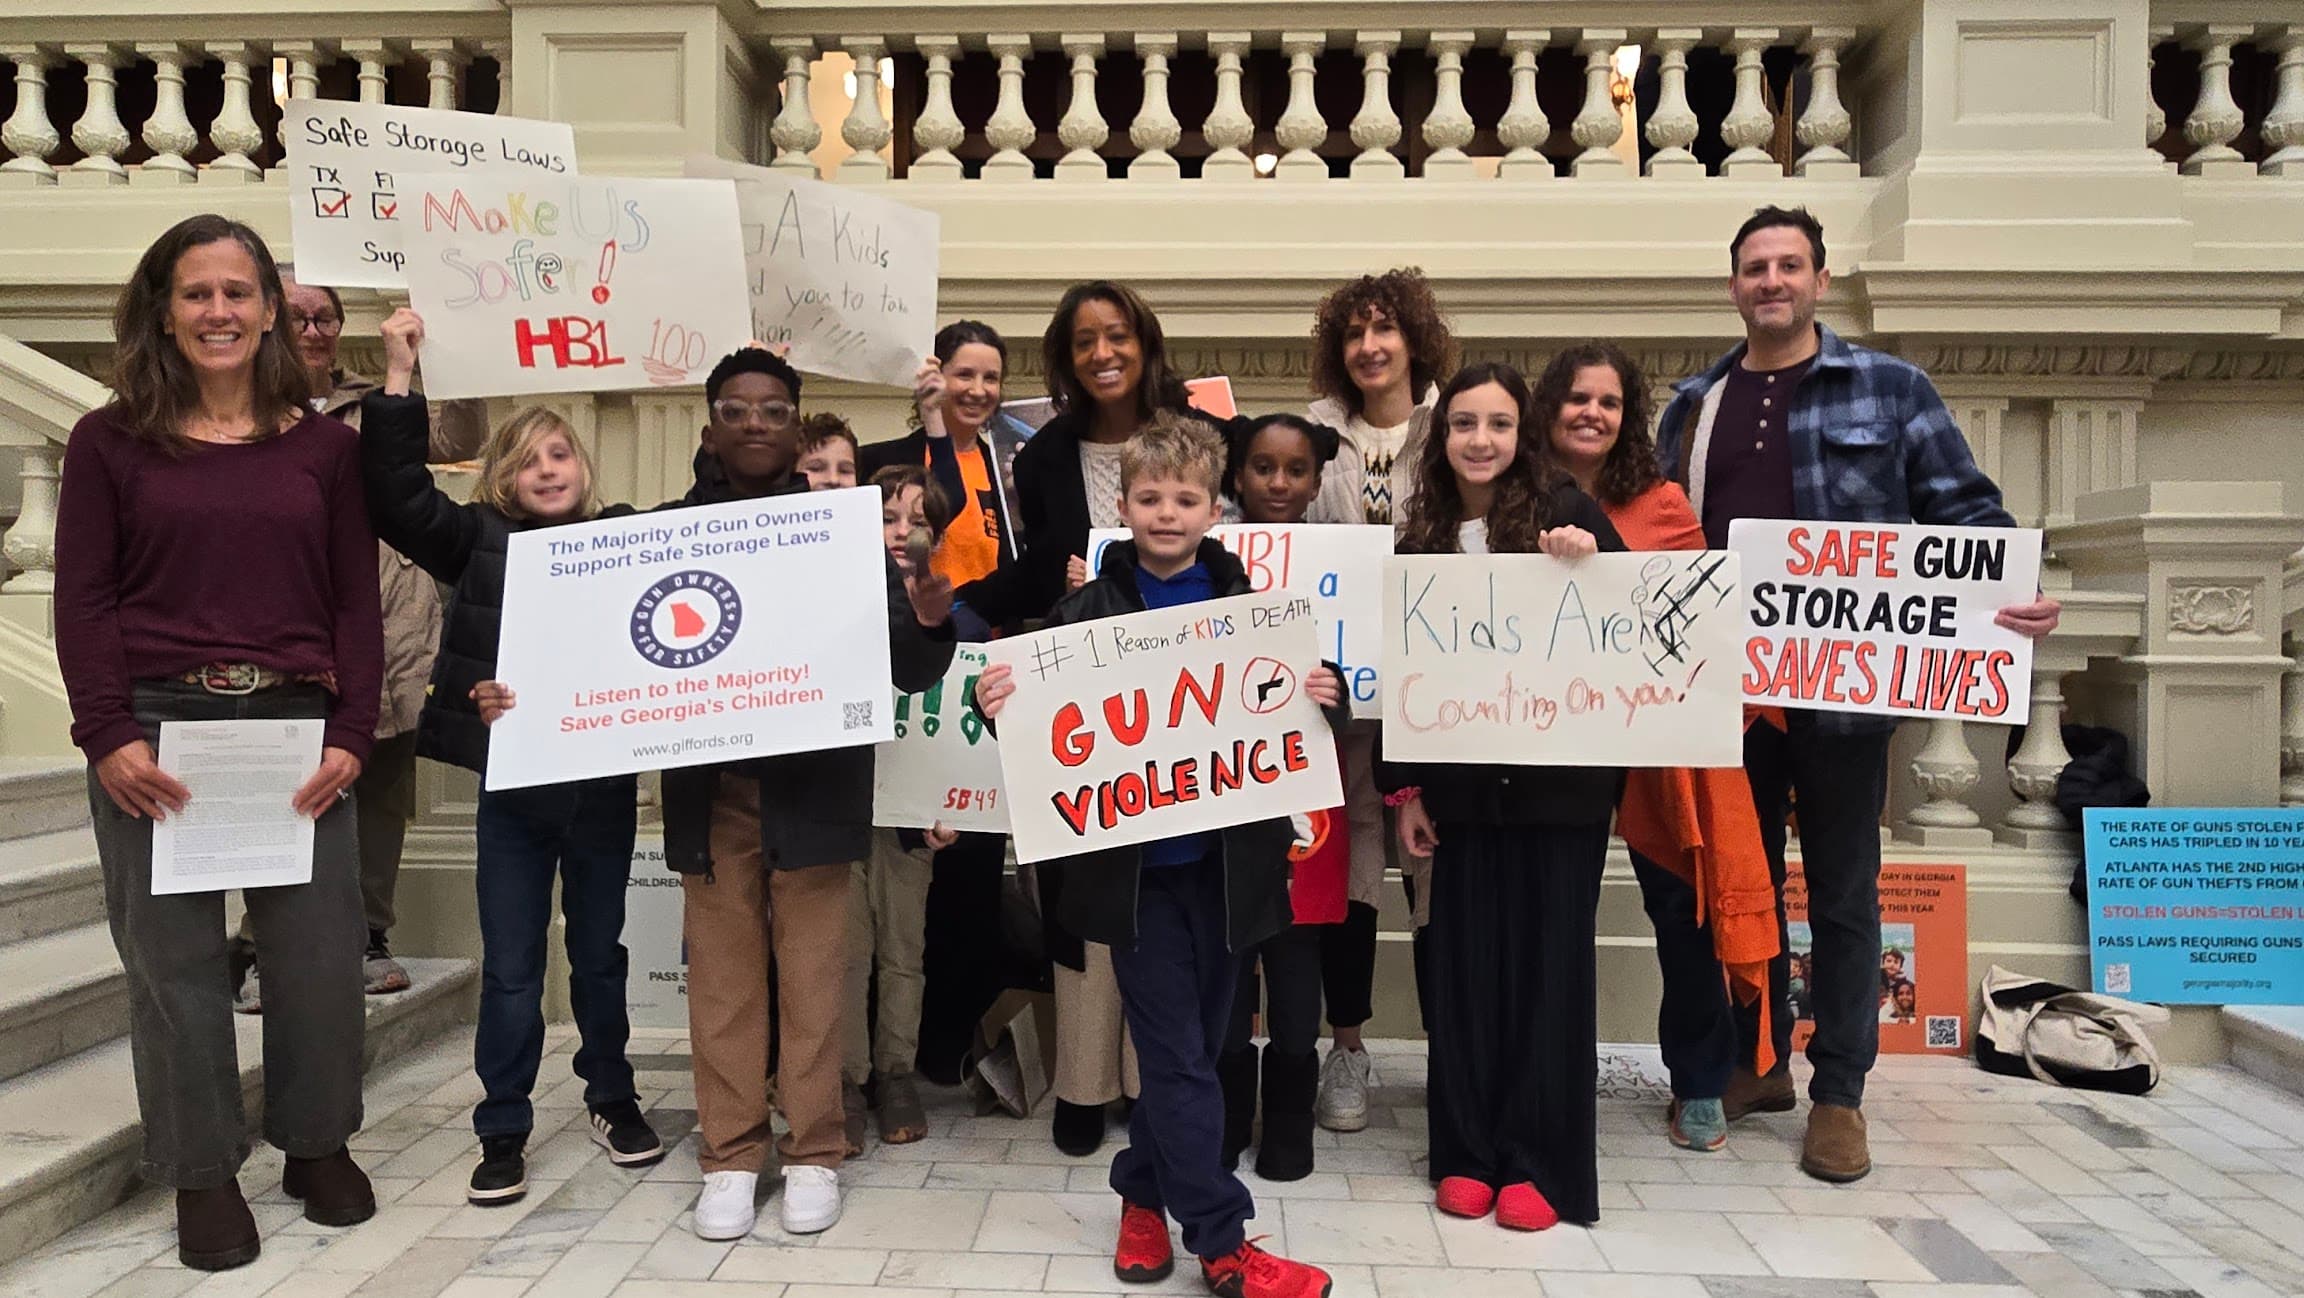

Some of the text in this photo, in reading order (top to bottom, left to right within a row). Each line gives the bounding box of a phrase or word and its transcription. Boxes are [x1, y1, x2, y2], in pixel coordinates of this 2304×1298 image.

[305, 116, 565, 173] Safe Storage Laws
[309, 164, 342, 184] TX
[424, 182, 650, 252] Make Us
[832, 205, 889, 268] Kids
[784, 283, 831, 319] you
[842, 280, 864, 311] to
[514, 315, 625, 369] HB1
[549, 508, 833, 556] The Majority of Gun Owners
[550, 530, 831, 577] Support Safe Storage Laws
[1786, 527, 2006, 581] SAFE GUN
[636, 573, 737, 620] GUN OWNERS
[1404, 569, 1633, 661] Kids Are
[1750, 581, 1958, 637] STORAGE
[638, 625, 733, 665] FOR SAFETY
[1113, 626, 1170, 660] Reason
[1176, 624, 1191, 645] of
[1194, 615, 1235, 641] KIDS
[1250, 597, 1311, 629] DEATH
[575, 663, 809, 707] Listen to the Majority!
[1742, 636, 2014, 717] SAVES LIVES
[560, 687, 823, 732] Save Georgia's Children
[1051, 661, 1225, 767] GUN
[1399, 670, 1557, 732] Counting
[1566, 677, 1604, 715] On
[632, 733, 753, 757] www.giffords.org
[1051, 730, 1308, 836] VIOLENCE
[2101, 821, 2128, 833] THE
[2131, 821, 2167, 833] RATE
[2170, 821, 2189, 833] OF
[2193, 821, 2233, 833] GUNS
[2236, 821, 2292, 833] STOLEN
[2109, 836, 2147, 848] CARS
[2151, 836, 2180, 848] HAS
[2183, 836, 2242, 848] TRIPLED
[2245, 836, 2259, 848] IN
[2264, 836, 2279, 848] 10
[626, 877, 684, 888] CHILDREN
[1881, 872, 1900, 881] DAY
[1914, 873, 1956, 882] GEORGIA
[2098, 877, 2135, 889] RATE
[2139, 877, 2157, 889] OF
[2162, 877, 2194, 889] GUN
[2197, 877, 2251, 889] THEFTS
[2256, 877, 2298, 889] FROM
[2105, 861, 2168, 873] ATLANTA
[2172, 861, 2201, 873] HAS
[2205, 862, 2233, 873] THE
[2237, 862, 2266, 874] 2ND
[1888, 904, 1909, 912] THIS
[1910, 904, 1935, 913] YEAR
[1915, 888, 1940, 897] THEM
[2103, 906, 2167, 919] STOLEN
[2098, 936, 2303, 949] PASS LAWS REQUIRING GUNS
[2190, 951, 2257, 963] SECURED
[649, 971, 679, 981] PASS
